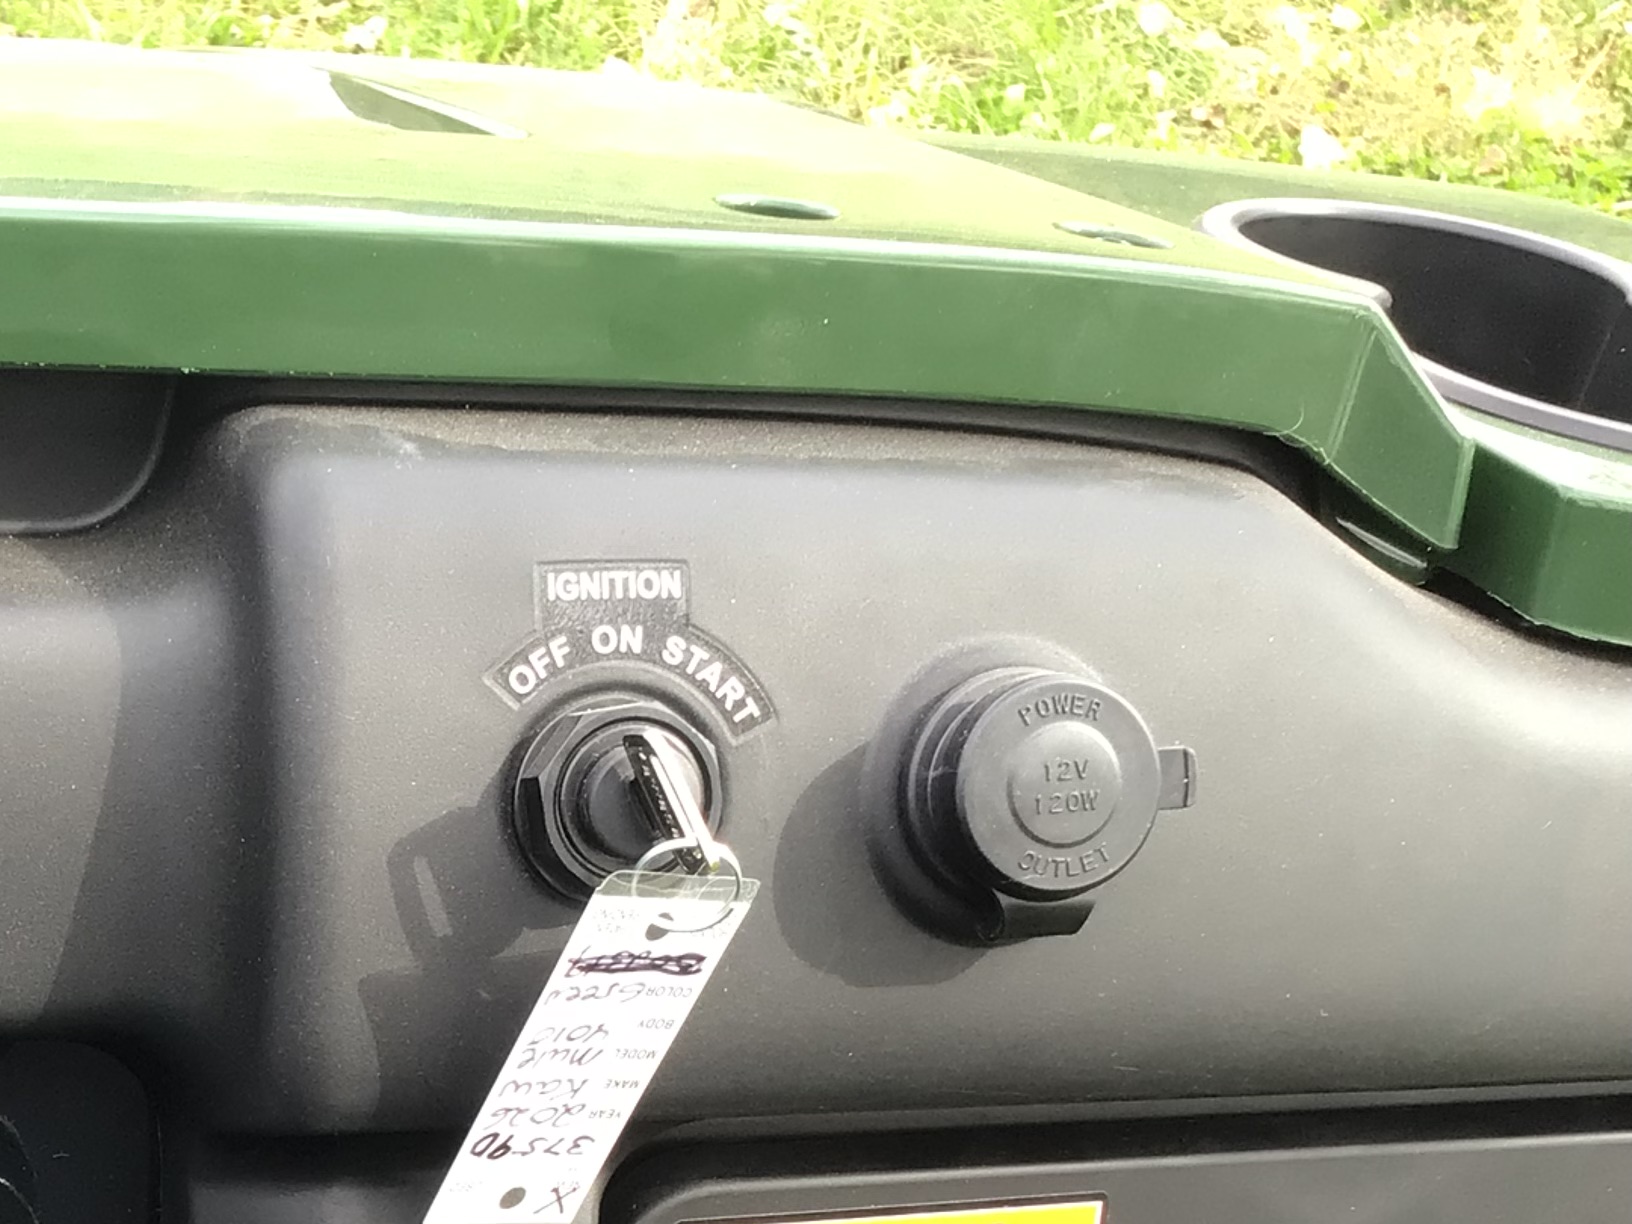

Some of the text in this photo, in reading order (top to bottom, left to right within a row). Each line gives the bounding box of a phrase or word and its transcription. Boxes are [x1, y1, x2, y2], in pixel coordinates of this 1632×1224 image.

[546, 570, 682, 600] IGNITION
[508, 624, 761, 724] OFF ON START
[1018, 693, 1101, 727] POWER
[1042, 758, 1090, 783] 12V
[1034, 789, 1099, 815] 120W
[1018, 841, 1110, 878] OUTLET
[637, 1019, 675, 1030] BODY
[615, 1048, 657, 1060] MODEL
[604, 1079, 640, 1090] MAKE
[589, 1108, 621, 1120] YEAR
